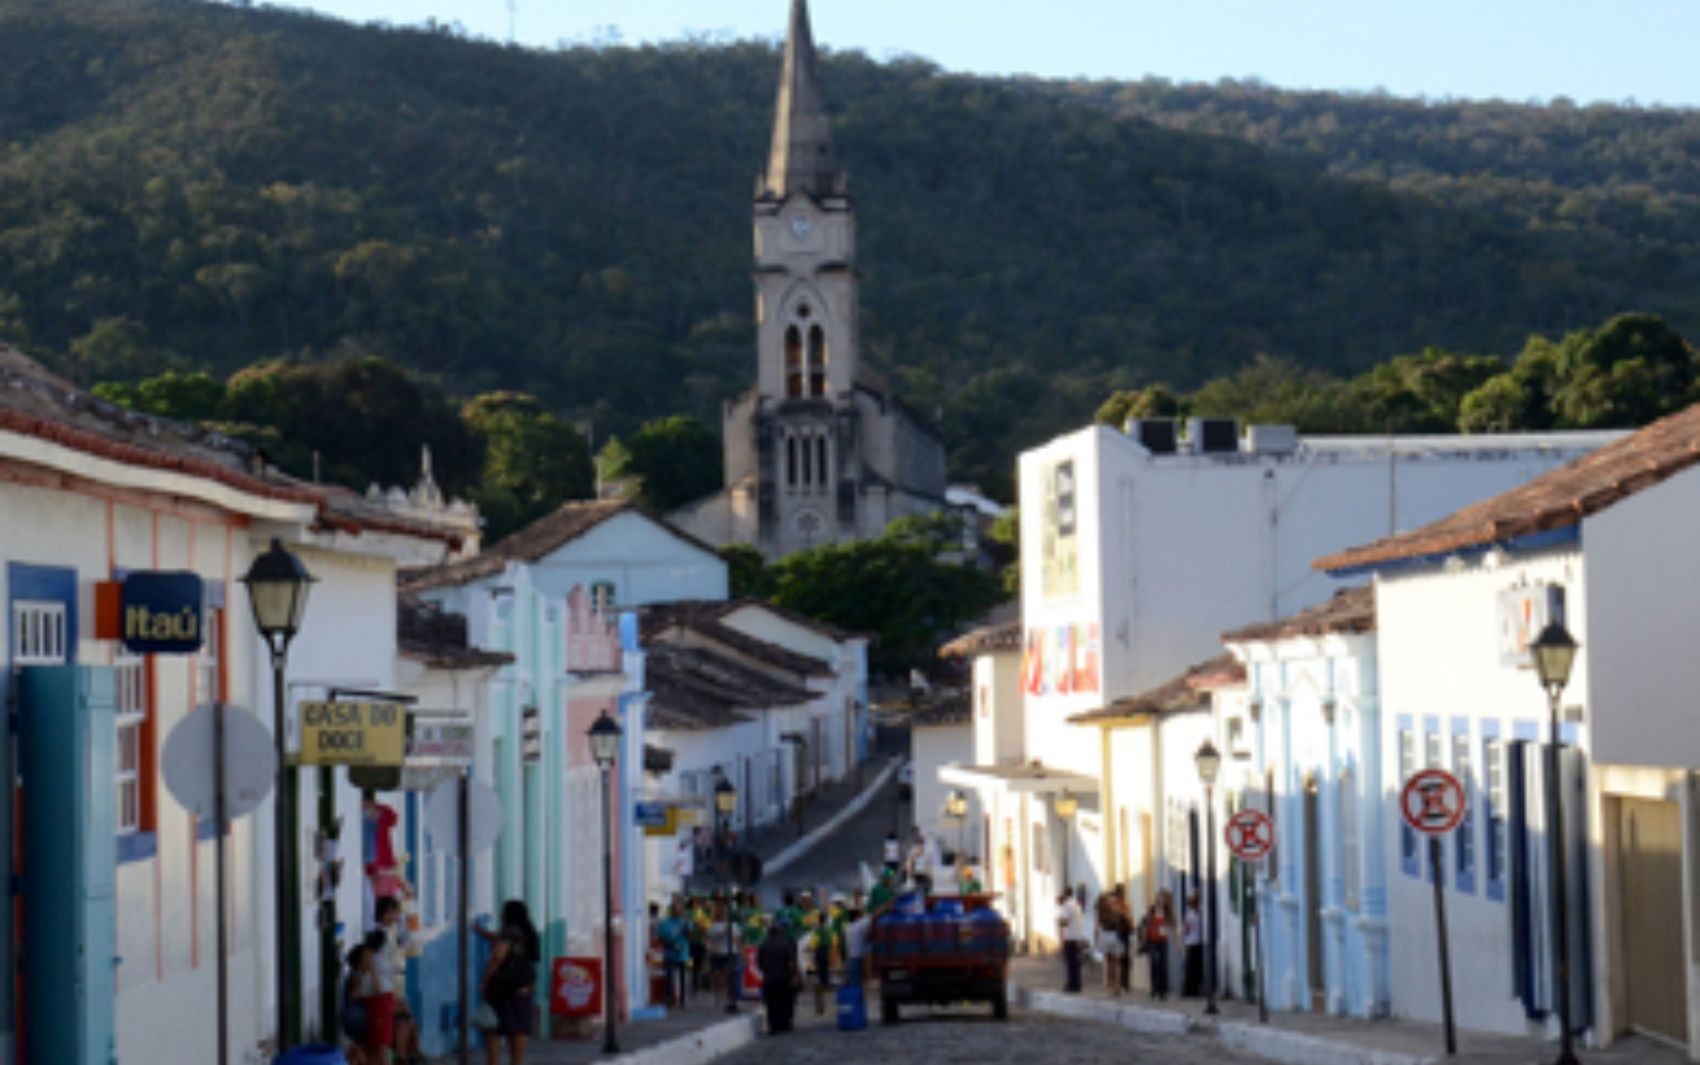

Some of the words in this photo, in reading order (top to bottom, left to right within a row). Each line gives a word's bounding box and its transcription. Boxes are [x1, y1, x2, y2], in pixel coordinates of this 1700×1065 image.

[125, 605, 197, 640] Itaú
[304, 702, 362, 727] CASA
[370, 702, 397, 727] DO
[318, 729, 364, 751] DOCE
